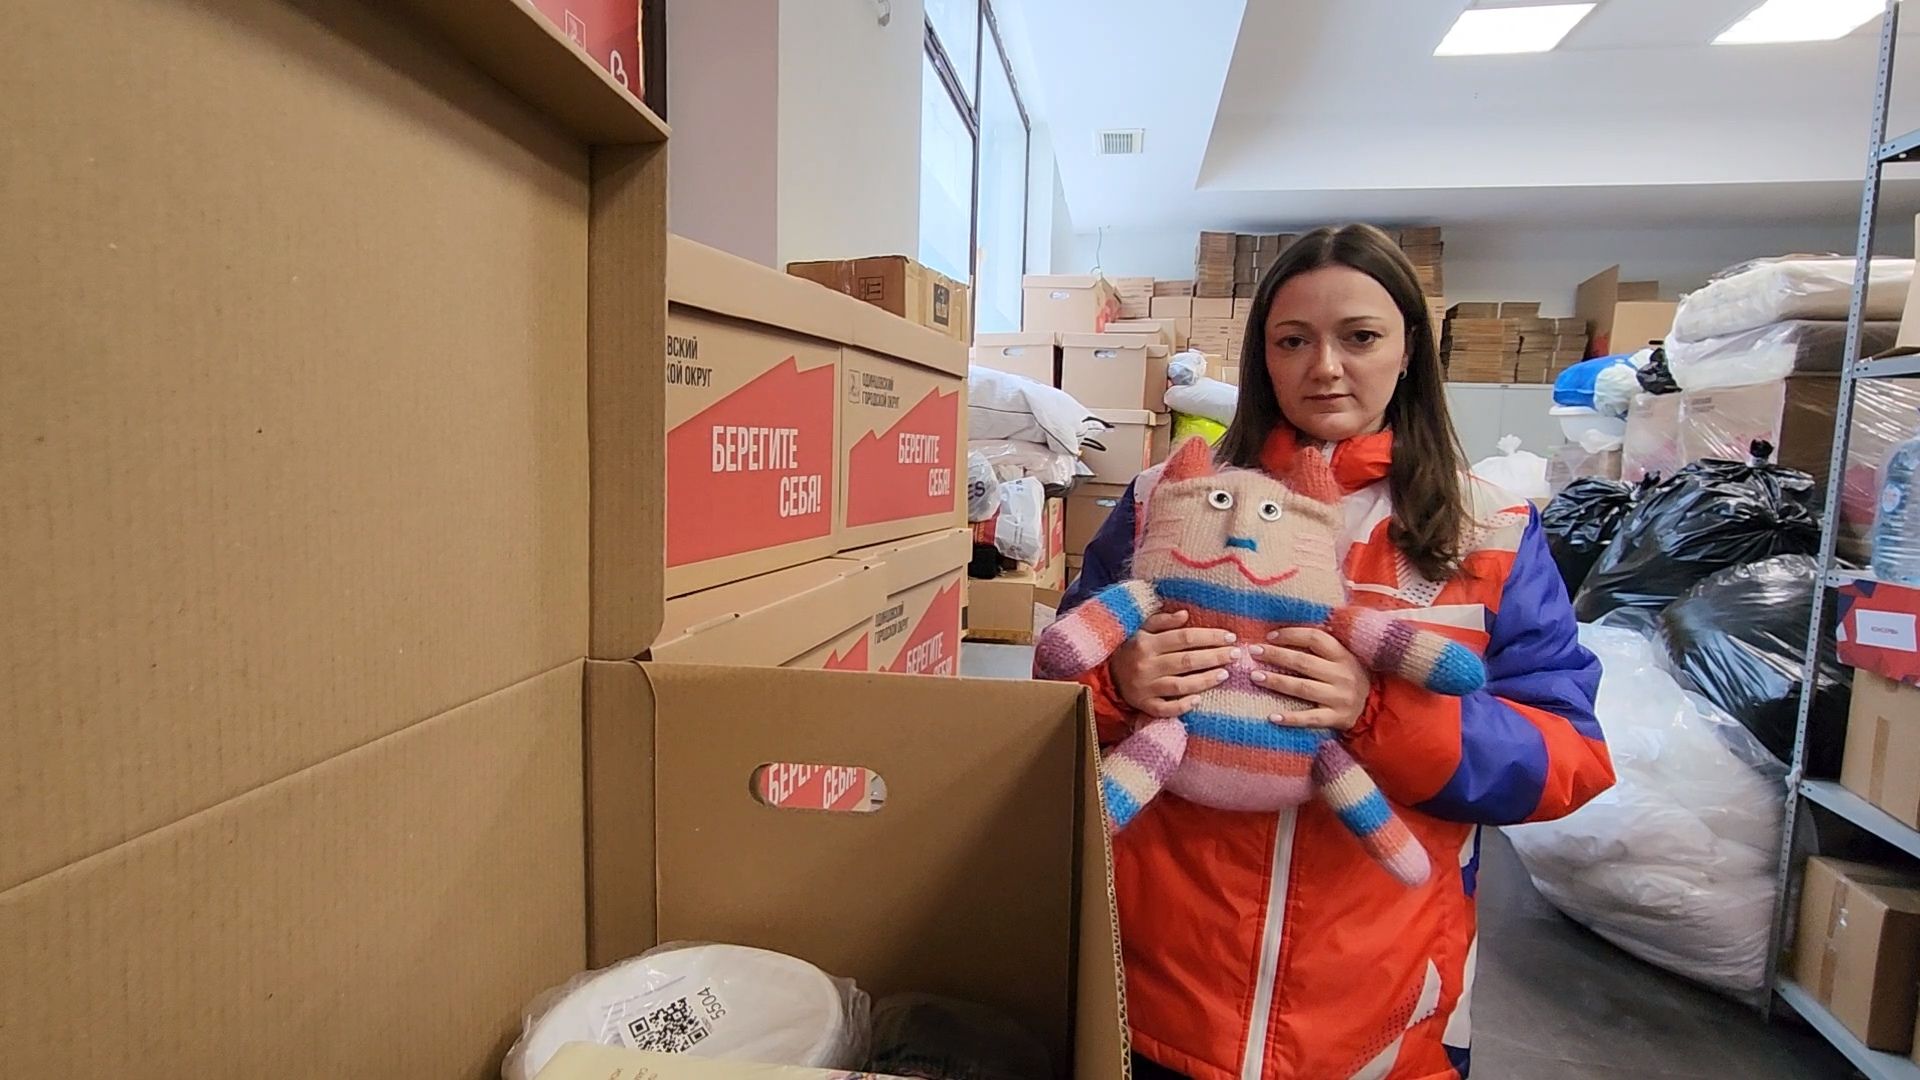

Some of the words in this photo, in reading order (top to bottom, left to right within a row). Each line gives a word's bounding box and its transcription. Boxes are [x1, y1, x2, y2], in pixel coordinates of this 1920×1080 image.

[667, 335, 698, 360] ВСКИЙ
[685, 365, 713, 387] ОКРУГ
[712, 425, 799, 472] БЕРЕГИТЕ
[898, 432, 940, 464] БЕРЕГИТЕ
[780, 475, 822, 518] СЕБЯ!
[928, 468, 951, 497] СЕБЯ!
[906, 631, 944, 674] БЕРЕГИТЕ
[697, 986, 727, 1021] 5504
